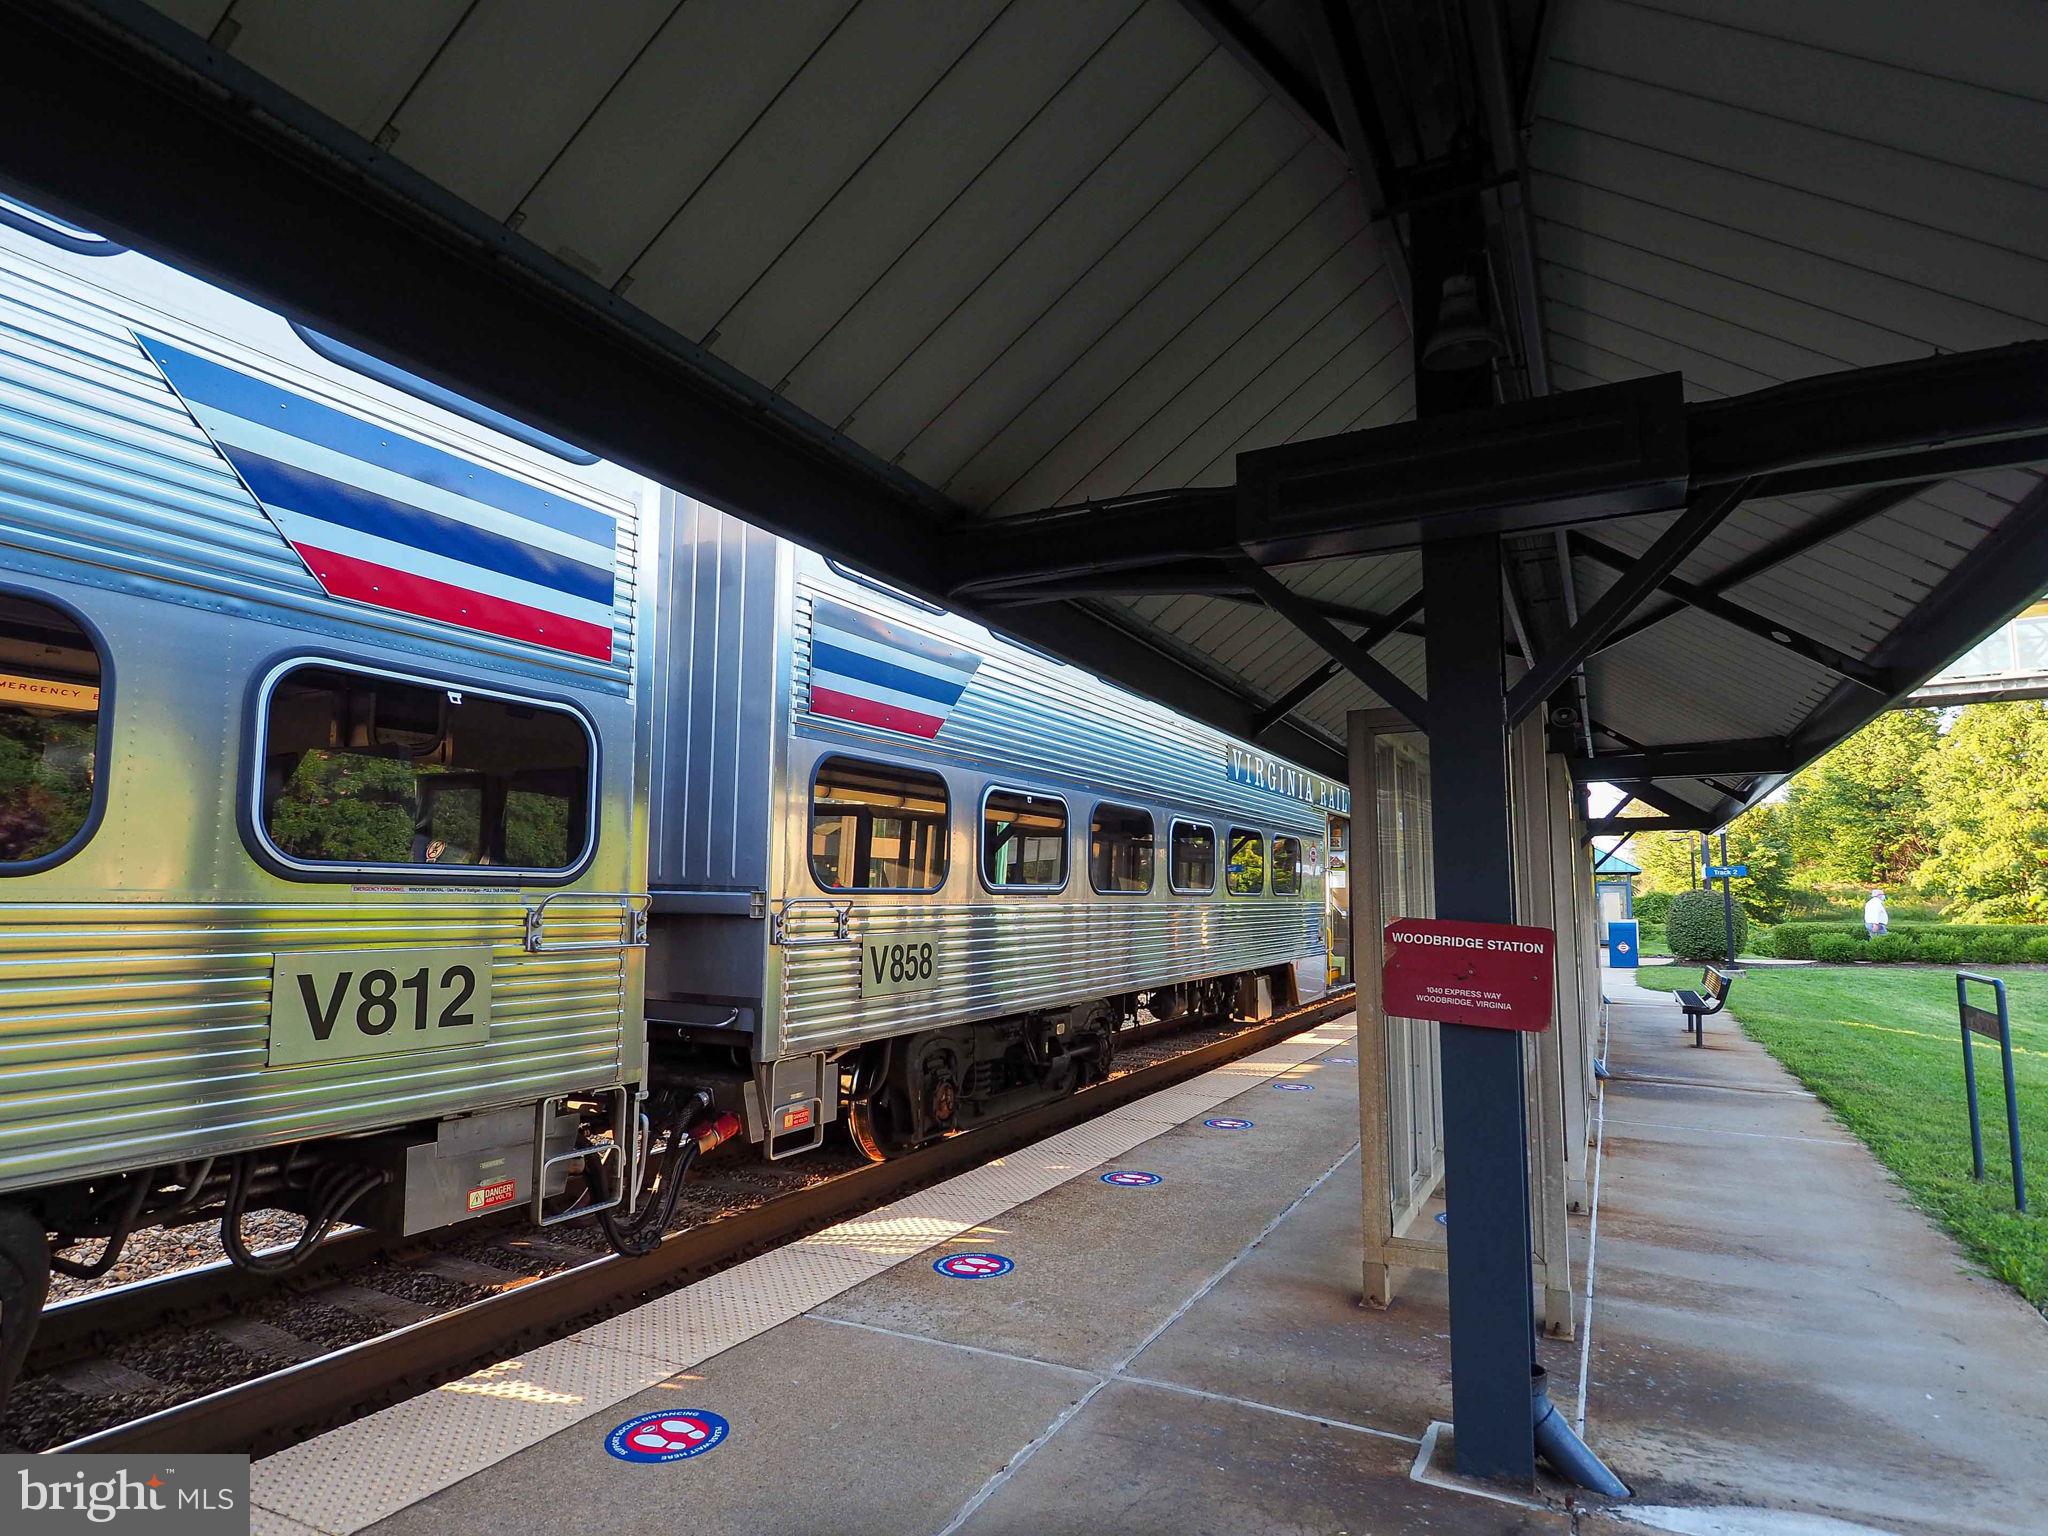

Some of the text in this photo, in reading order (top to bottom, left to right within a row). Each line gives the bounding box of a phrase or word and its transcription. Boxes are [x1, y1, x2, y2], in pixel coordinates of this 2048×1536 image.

[0, 680, 81, 698] MERGENCY
[1232, 748, 1350, 813] VIRGINIA RAIL
[1391, 932, 1544, 954] WOODBRIDGE STATION
[870, 942, 933, 984] V858
[1426, 986, 1502, 1000] 1040 EXPRESS WAY
[296, 964, 476, 1041] V812
[1416, 994, 1512, 1011] WOODBRIDGE, VIRGINIA
[485, 1183, 514, 1198] DANGER!
[495, 1192, 513, 1201] VOLTS
[616, 1420, 642, 1436] SOCIAL
[641, 1411, 700, 1422] DISTANCING
[660, 1452, 688, 1461] HERE
